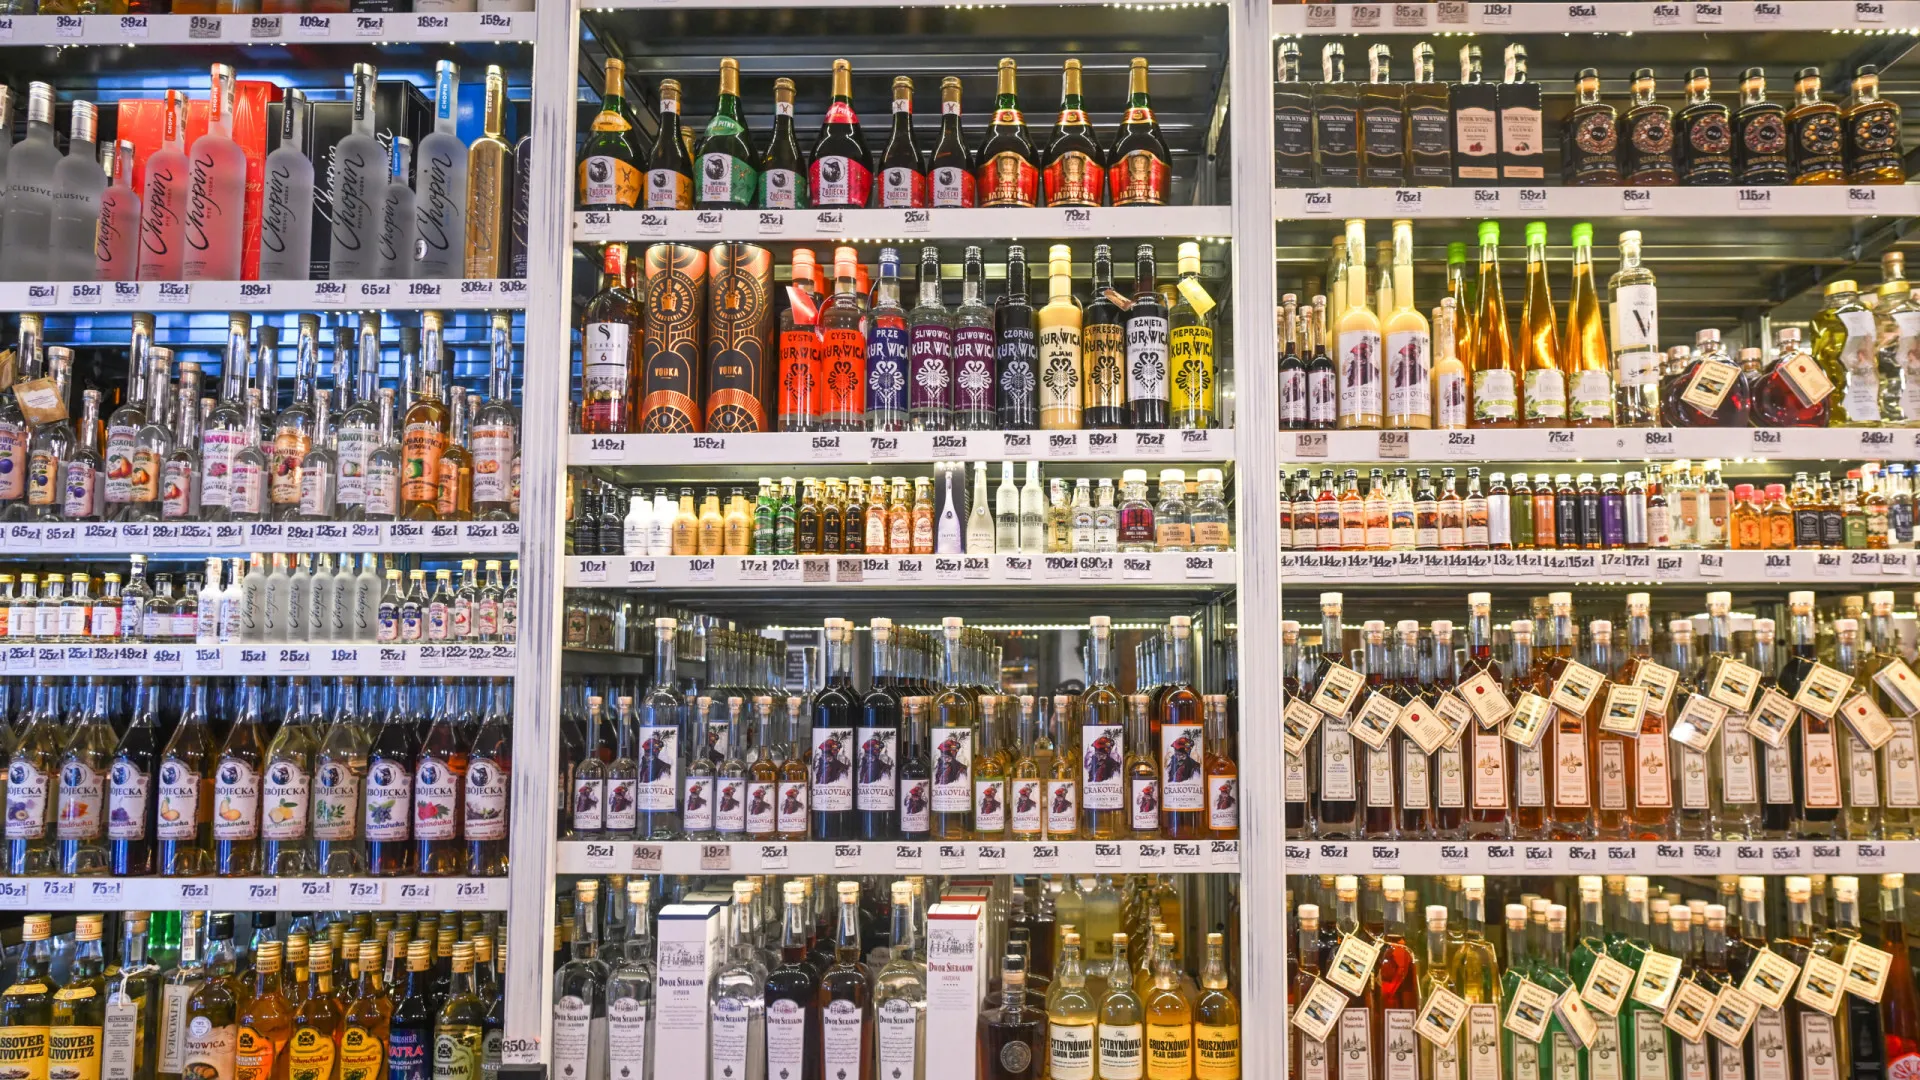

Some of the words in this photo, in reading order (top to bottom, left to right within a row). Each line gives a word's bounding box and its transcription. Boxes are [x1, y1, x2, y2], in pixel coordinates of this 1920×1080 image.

[1308, 6, 1335, 17] 79zł
[1352, 6, 1381, 18] 79zł
[1396, 6, 1424, 18] 95zł
[1483, 4, 1512, 15] 119zł
[1654, 4, 1680, 16] 45zł
[1755, 4, 1781, 16] 45zł
[1857, 3, 1883, 15] 85zł
[56, 16, 82, 27] 39zł
[121, 16, 147, 27] 39zł
[190, 17, 220, 31] 99zł
[252, 17, 280, 28] 99zł
[299, 16, 330, 28] 109zł
[417, 16, 448, 28] 189zł
[480, 15, 511, 27] 159zł
[1306, 192, 1332, 204] 75zł
[1520, 189, 1546, 201] 59zł
[1623, 190, 1650, 202] 85zł
[1739, 189, 1771, 201] 115zł
[1849, 189, 1875, 201] 85zł
[585, 213, 611, 224] 35zł
[641, 214, 667, 226] 22zł
[697, 212, 722, 224] 45zł
[817, 212, 843, 224] 45zł
[904, 210, 930, 222] 25zł
[1065, 209, 1091, 221] 79zł
[73, 285, 101, 297] 59zł
[159, 283, 190, 295] 125zł
[240, 284, 271, 296] 139zł
[315, 283, 347, 295] 199zł
[362, 283, 390, 295] 65zł
[409, 283, 441, 295] 199zł
[461, 281, 493, 293] 309zł
[876, 329, 898, 338] PRZE
[655, 367, 679, 377] VODKA
[719, 366, 743, 376] VODKA
[932, 435, 967, 447] 125zł
[1004, 434, 1031, 446] 75zł
[1049, 434, 1077, 446] 59zł
[1182, 431, 1208, 442] 75zł
[1379, 432, 1409, 445] 49zł
[1548, 432, 1574, 444] 75zł
[1646, 432, 1673, 444] 89zł
[1754, 431, 1781, 443] 59zł
[591, 438, 625, 450] 149zł
[693, 438, 725, 450] 159zł
[870, 438, 898, 450] 75zł
[11, 526, 41, 539] 65zł
[46, 528, 75, 539] 35zł
[84, 526, 117, 538] 125zł
[122, 525, 149, 537] 65zł
[250, 524, 283, 536] 109zł
[287, 527, 314, 539] 29zł
[316, 525, 347, 537] 125zł
[353, 525, 379, 537] 29zł
[431, 525, 458, 537] 45zł
[580, 560, 607, 572] 10zł
[689, 559, 715, 571] 10zł
[741, 560, 768, 572] 17zł
[772, 559, 800, 571] 20zł
[863, 559, 889, 571] 19zł
[898, 560, 922, 572] 16zł
[936, 559, 962, 571] 25zł
[1045, 557, 1078, 569] 790zł
[1124, 559, 1151, 571] 35zł
[1186, 558, 1213, 570] 39zł
[1568, 556, 1595, 568] 15zł
[1657, 557, 1682, 569] 15zł
[1766, 555, 1791, 567] 10zł
[39, 648, 65, 660] 25zł
[119, 647, 148, 660] 49zł
[153, 650, 180, 662] 49zł
[196, 649, 220, 661] 15zł
[240, 650, 266, 662] 15zł
[331, 649, 357, 661] 19zł
[381, 649, 406, 661] 25zł
[634, 847, 662, 860] 49zł
[703, 845, 730, 857] 19zł
[762, 846, 788, 858] 25zł
[835, 845, 862, 857] 55zł
[897, 846, 922, 858] 25zł
[1095, 844, 1121, 856] 55zł
[1211, 842, 1238, 854] 25zł
[1321, 845, 1348, 858] 85zł
[1373, 846, 1399, 859] 55zł
[1488, 845, 1514, 858] 85zł
[1526, 847, 1553, 859] 55zł
[1608, 847, 1636, 859] 55zł
[1657, 845, 1684, 858] 85zł
[1738, 846, 1764, 859] 85zł
[1773, 847, 1800, 860] 55zł
[1813, 845, 1840, 858] 85zł
[92, 882, 121, 895] 75zł
[181, 884, 209, 897] 75zł
[302, 882, 330, 895] 75zł
[350, 882, 379, 895] 75zł
[457, 882, 485, 895] 75zł
[1100, 1037, 1141, 1051] CYTRYNÓWKA
